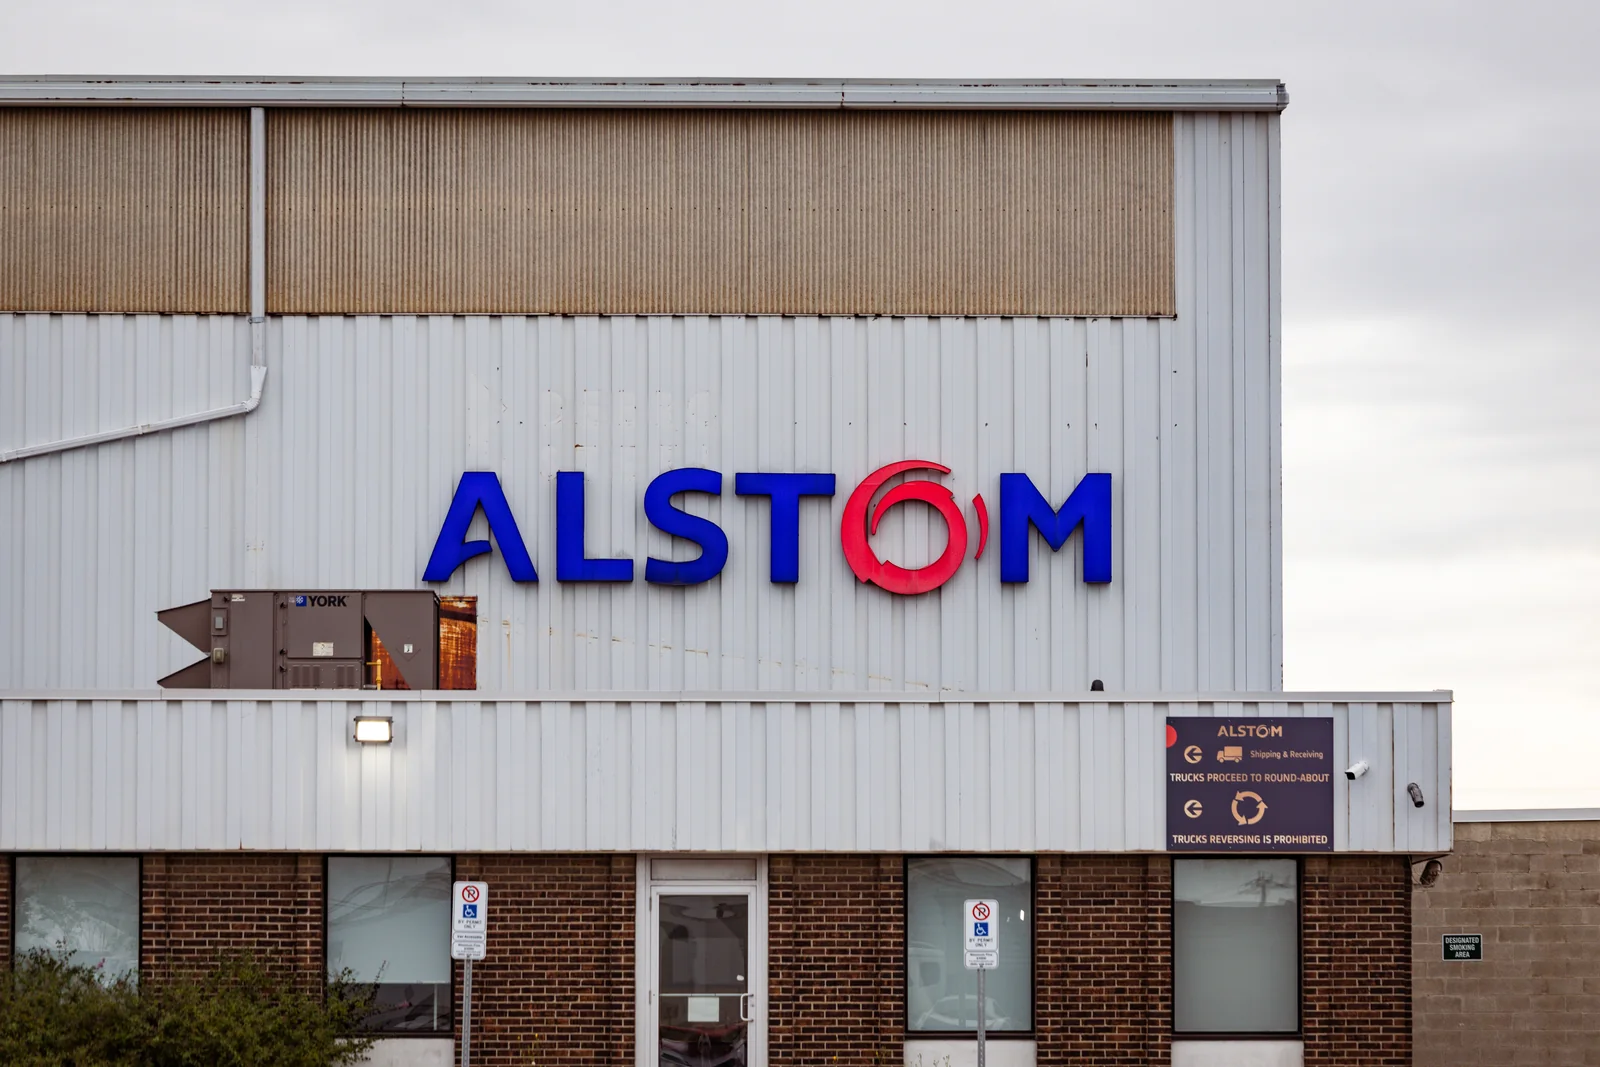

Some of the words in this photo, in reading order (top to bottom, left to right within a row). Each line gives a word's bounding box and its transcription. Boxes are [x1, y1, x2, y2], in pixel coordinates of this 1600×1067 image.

[422, 460, 1112, 595] ALSTOM
[308, 595, 347, 607] YORK
[1217, 724, 1283, 739] ALSTOM
[1250, 750, 1281, 760] Shipping
[1290, 750, 1324, 760] Receiving
[1170, 773, 1205, 782] TRUCKS
[1207, 773, 1248, 783] PROCEED
[1250, 773, 1262, 782] TO
[1264, 773, 1330, 783] ROUND-ABOUT
[1172, 835, 1207, 844] TRUCKS
[1210, 835, 1261, 844] REVERSING
[1263, 835, 1271, 844] IS
[1273, 835, 1328, 844] PROHIBITED
